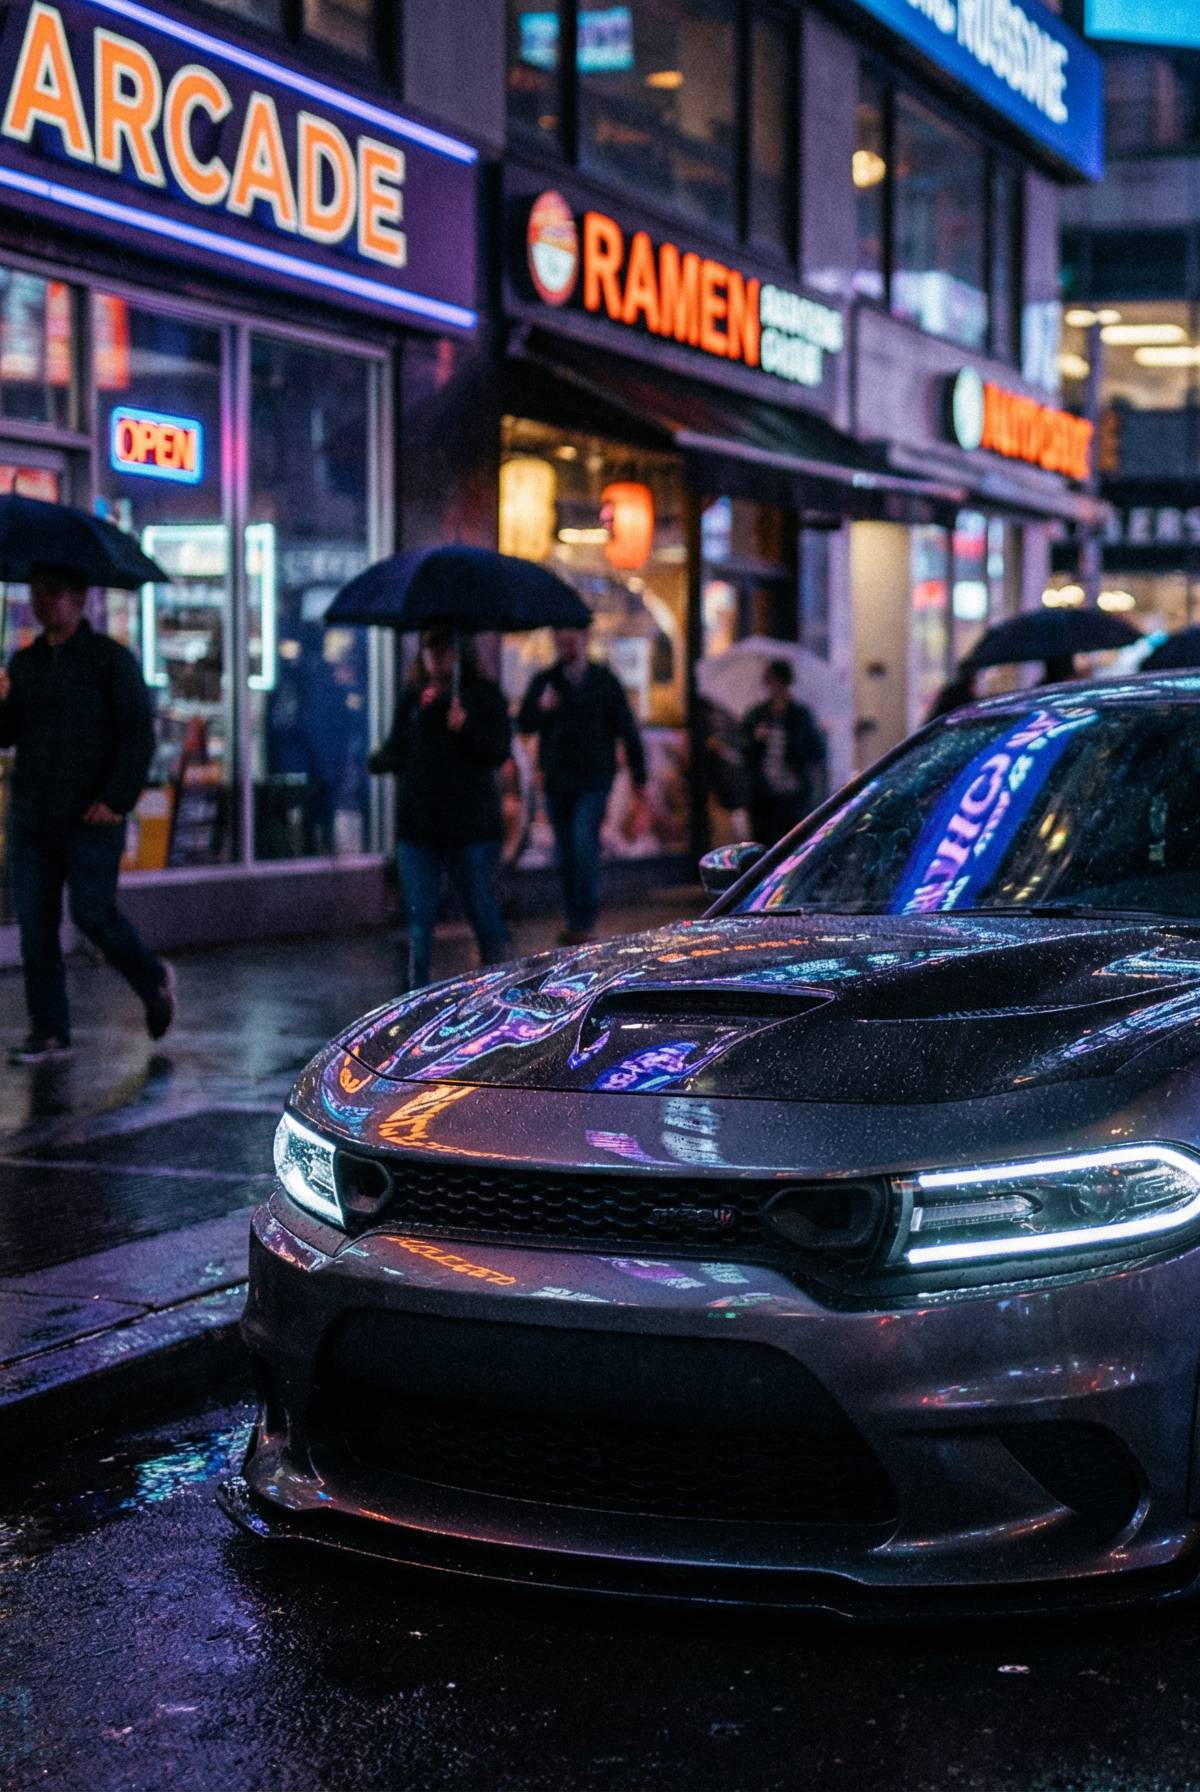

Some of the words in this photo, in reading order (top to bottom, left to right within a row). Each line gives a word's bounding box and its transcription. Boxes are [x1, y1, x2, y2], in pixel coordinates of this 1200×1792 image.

[3, 1, 406, 268] ARCADE
[583, 210, 761, 367] RAMEN
[118, 417, 194, 471] OPEN
